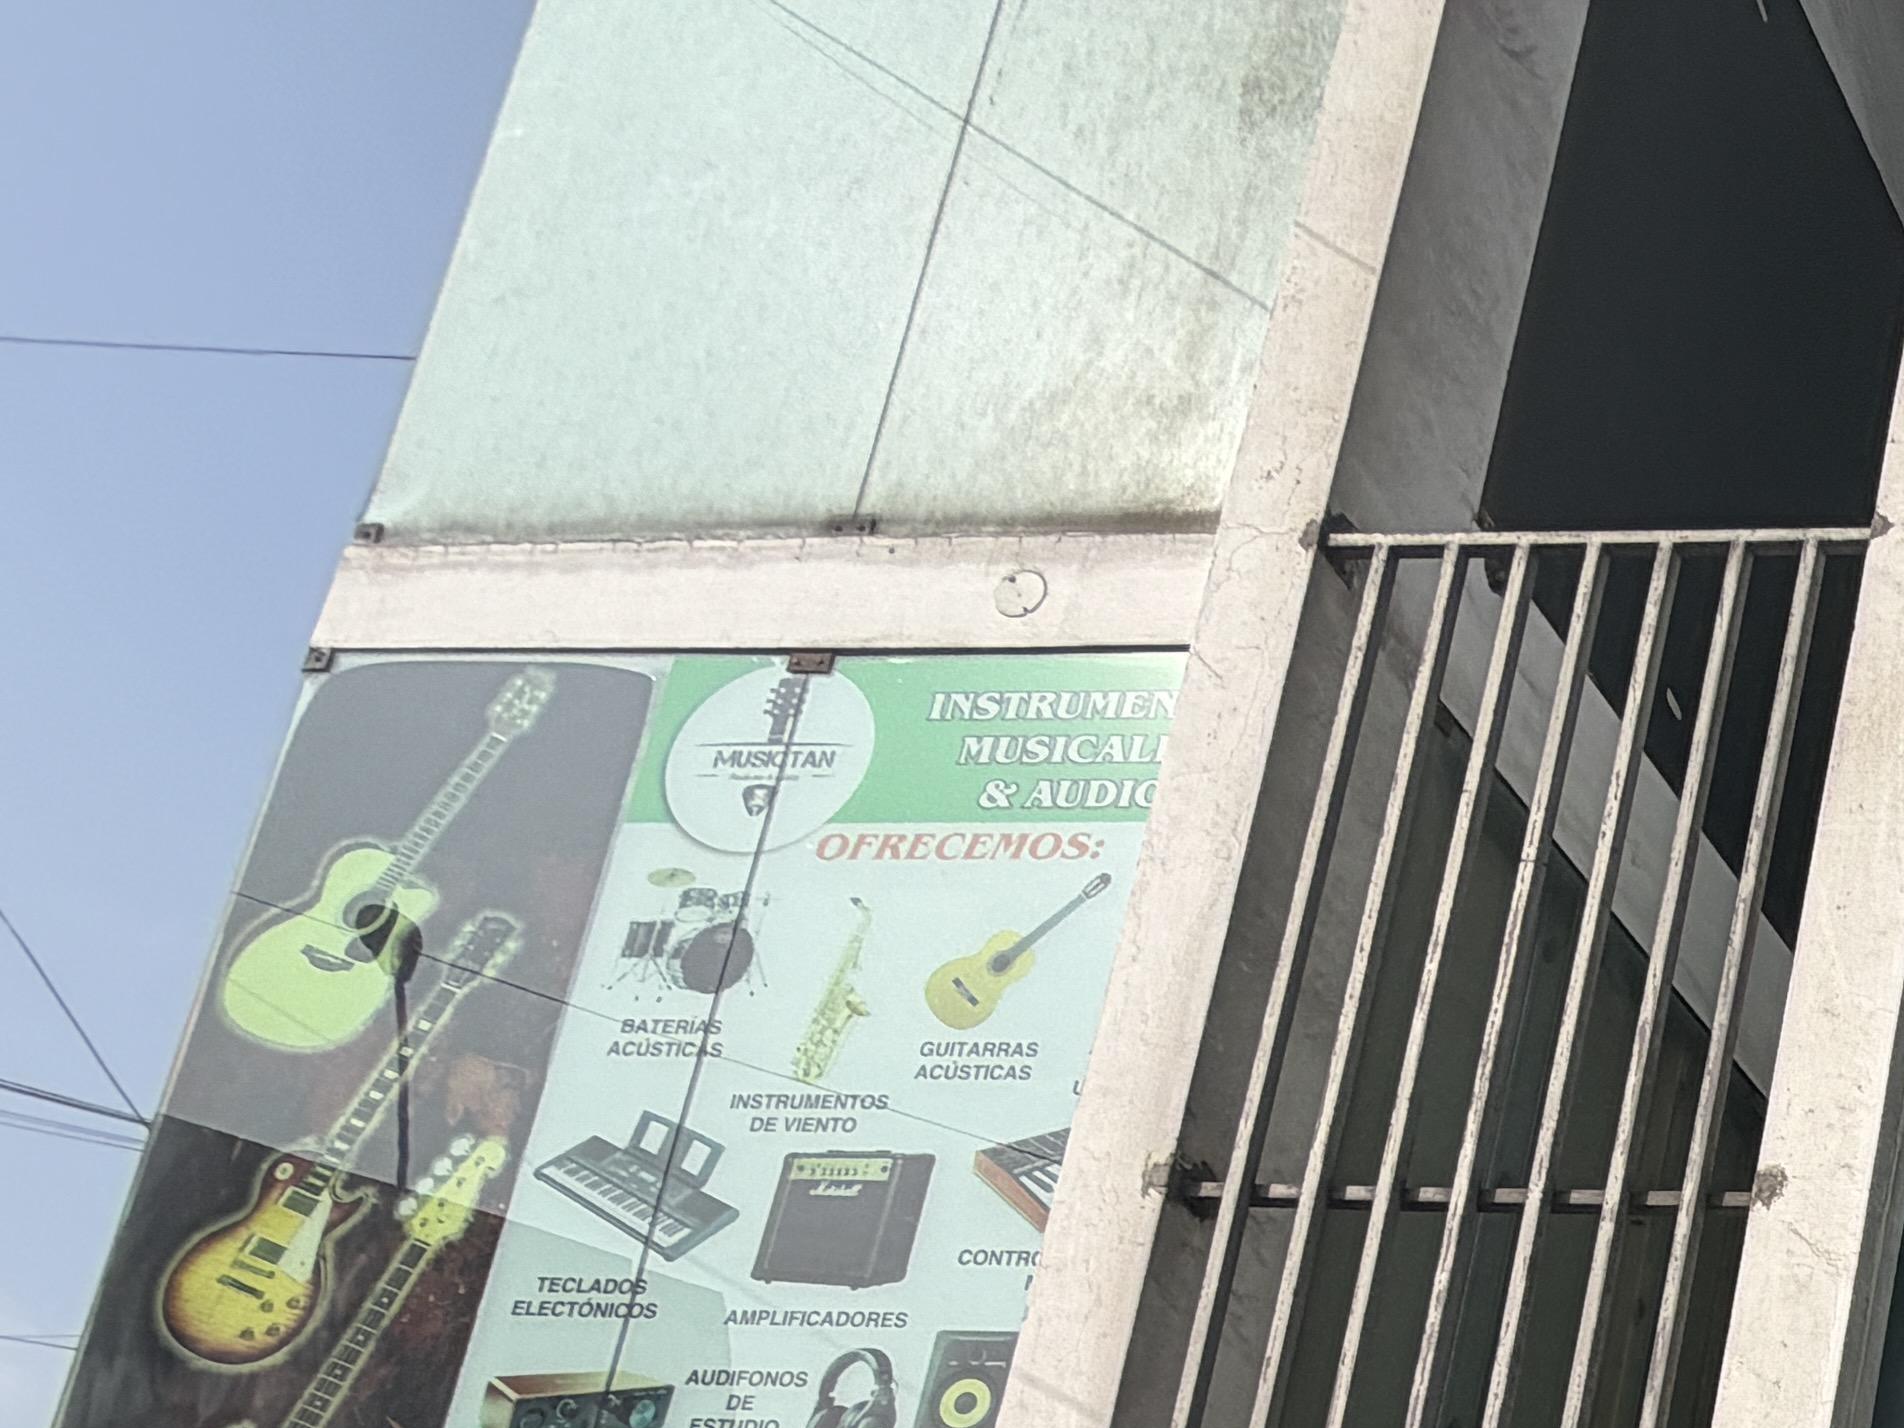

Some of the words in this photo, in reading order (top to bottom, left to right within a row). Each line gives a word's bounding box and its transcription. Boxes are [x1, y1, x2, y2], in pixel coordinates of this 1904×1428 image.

[814, 832, 1105, 862] OFRECEMOS:
[918, 1041, 1039, 1059] GUITARRAS
[914, 1061, 1032, 1082] ACÚSTICAS
[729, 1092, 889, 1111] INSTRUMENTOS
[749, 1116, 780, 1133] DE
[783, 1116, 857, 1134] VIENTO
[536, 1276, 648, 1296] TECLADOS
[723, 1309, 909, 1328] AMPLIFICADORES
[685, 1369, 808, 1388] AUDIFONOS
[726, 1394, 754, 1411] DE
